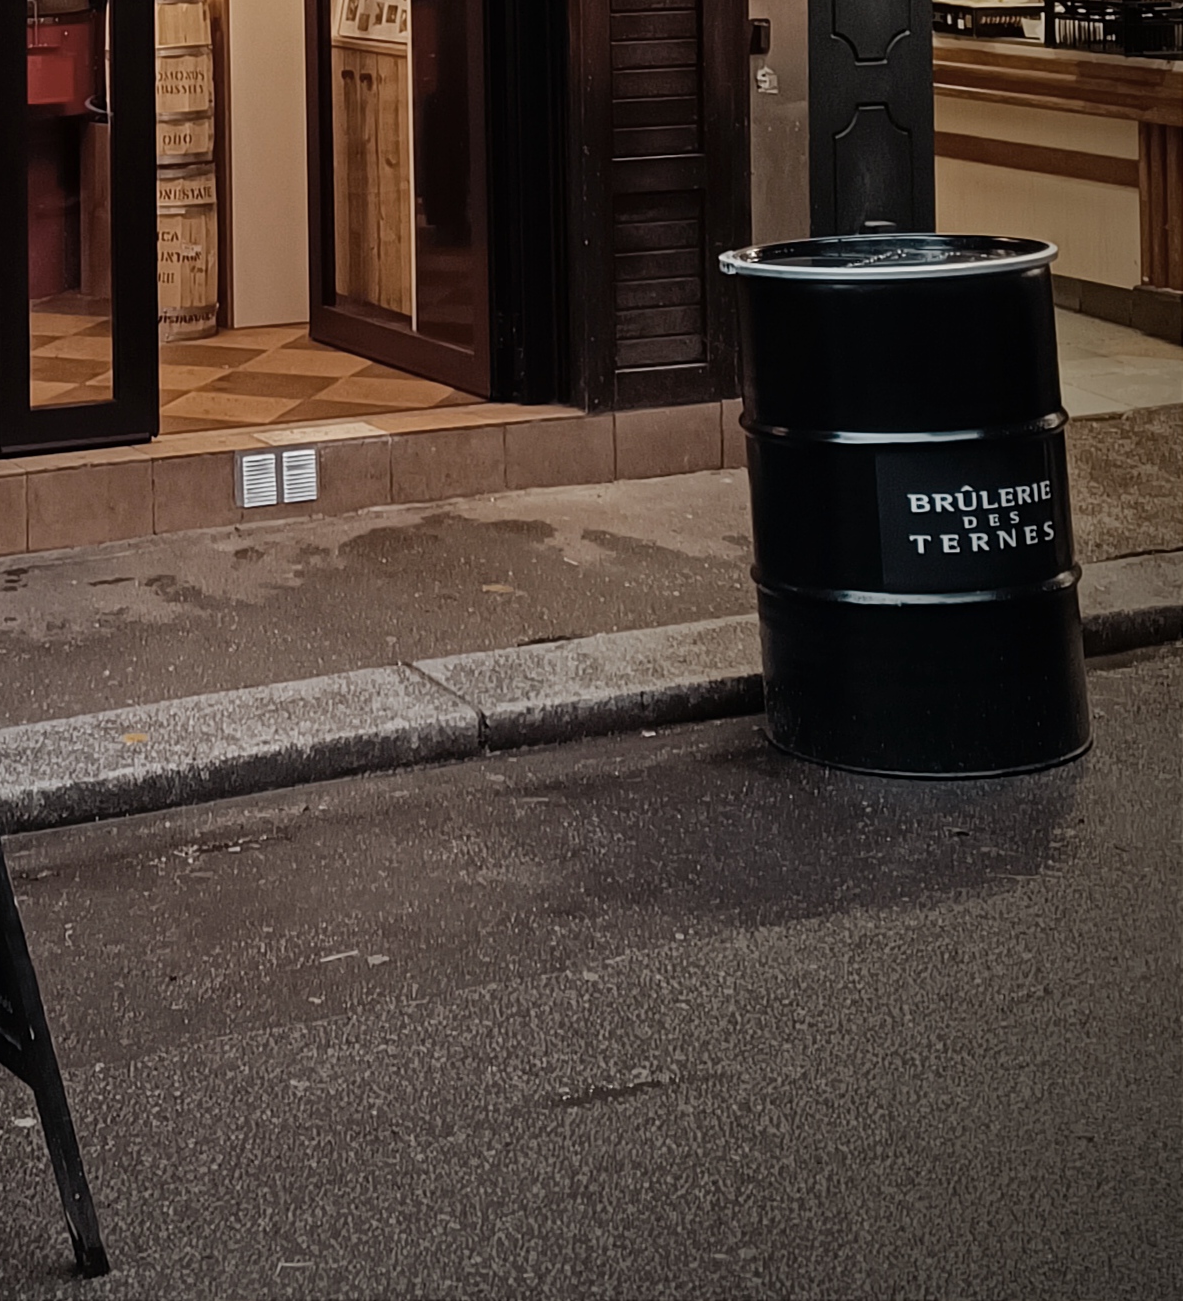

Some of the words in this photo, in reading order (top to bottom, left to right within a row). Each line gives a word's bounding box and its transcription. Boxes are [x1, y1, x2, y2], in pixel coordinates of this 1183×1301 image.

[907, 480, 1052, 514] BRÛLERIE
[962, 510, 1021, 530] DES
[909, 521, 1055, 555] TERNES
